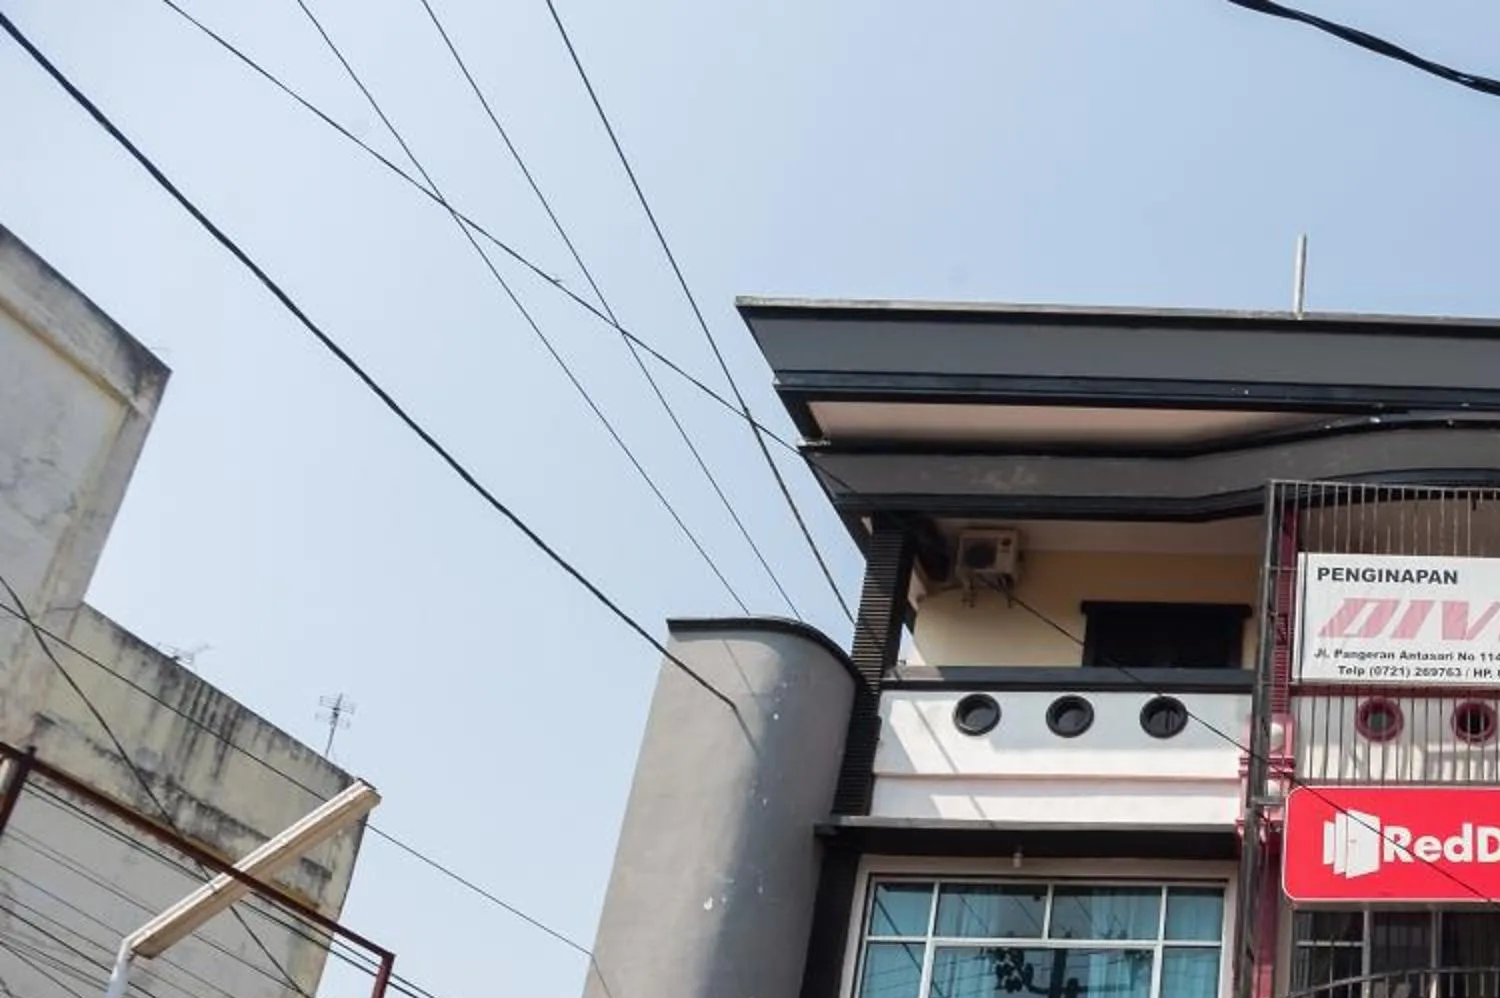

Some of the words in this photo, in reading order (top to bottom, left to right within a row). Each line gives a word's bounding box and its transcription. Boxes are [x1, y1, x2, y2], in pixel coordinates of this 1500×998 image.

[1316, 567, 1459, 585] PENGINAPAN
[1334, 648, 1395, 661] Pangeran
[1399, 650, 1453, 661] Antasari
[1458, 652, 1475, 661] No
[1338, 665, 1365, 677] Telp
